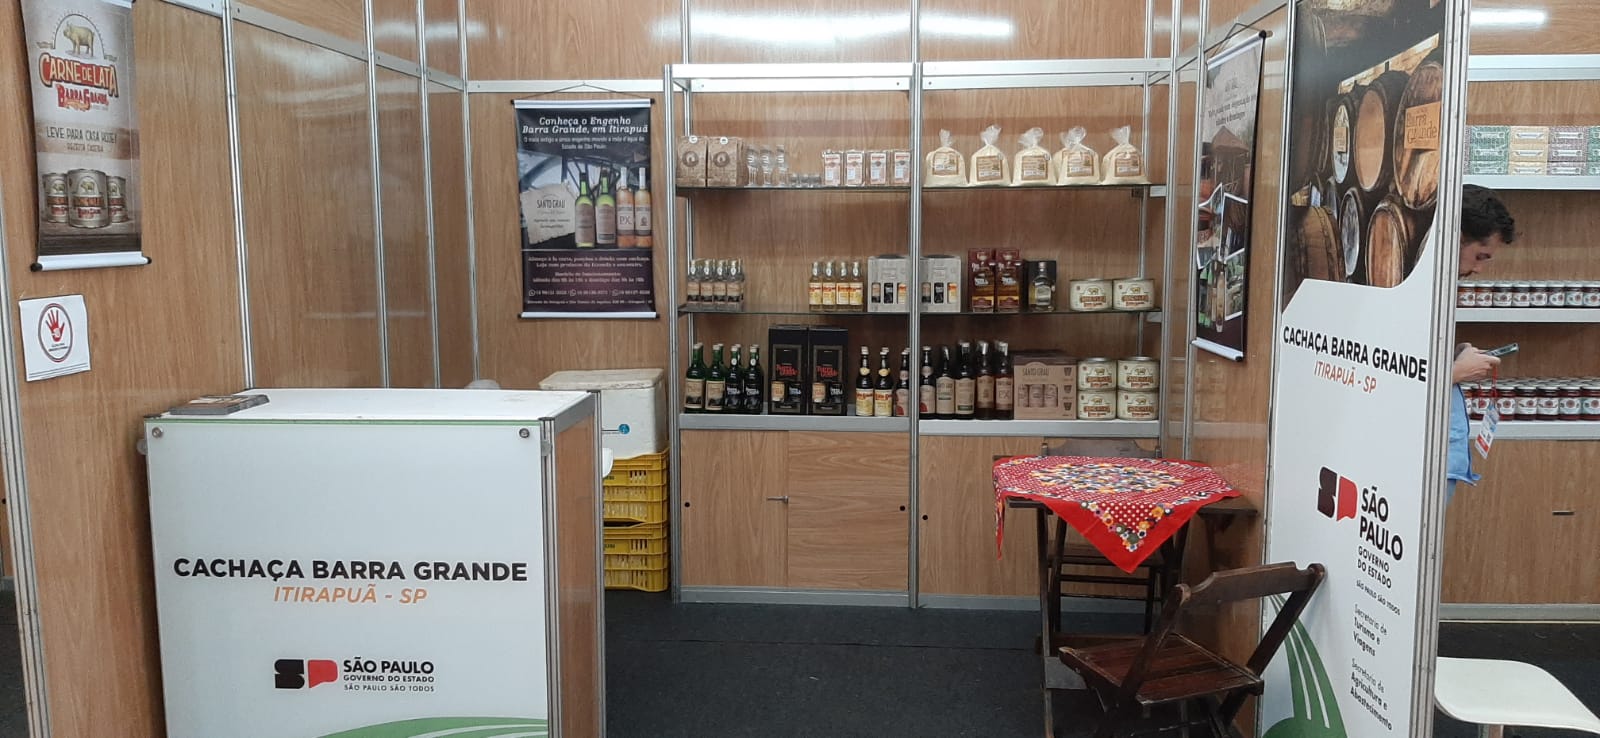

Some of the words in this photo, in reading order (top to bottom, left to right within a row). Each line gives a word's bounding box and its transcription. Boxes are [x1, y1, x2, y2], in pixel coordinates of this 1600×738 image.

[39, 52, 81, 88] CARNE
[82, 66, 93, 82] DE
[93, 64, 119, 98] LATA
[46, 126, 65, 139] LEVE
[66, 128, 83, 141] PARA
[85, 130, 100, 142] CASA
[522, 126, 549, 134] Barra
[551, 125, 590, 135] Grande,
[592, 126, 606, 134] em
[608, 124, 648, 135] Itirapuã
[539, 116, 579, 127] Conheça
[590, 116, 631, 127] Engenho
[1283, 325, 1328, 356] CACHAÇA
[1331, 336, 1369, 366] BARRA
[1372, 347, 1428, 382] GRANDE
[1314, 360, 1355, 387] ITIRAPUÃ
[1363, 375, 1377, 394] SP
[1361, 485, 1389, 522] SÃO
[1360, 515, 1403, 561] PAULO
[173, 557, 305, 582] CACHAÇA
[312, 559, 406, 581] BARRA
[413, 561, 528, 582] GRANDE
[1358, 545, 1390, 573] GOVERNO
[1357, 559, 1367, 572] DO
[1368, 566, 1392, 589] ESTADO
[273, 583, 378, 604] ITIRAPUÃ
[398, 588, 428, 604] SP
[1354, 617, 1376, 641] Turismo
[1353, 630, 1376, 657] Viagens
[343, 656, 377, 674] SÃO
[381, 660, 434, 674] PAULO
[343, 674, 385, 682] GOVERNO
[402, 675, 435, 683] ESTADO
[344, 682, 360, 691] SÃO
[362, 684, 387, 692] PAULO
[390, 683, 406, 692] SÃO
[1351, 671, 1383, 706] Agricultura
[1350, 685, 1393, 731] Abastecimento
